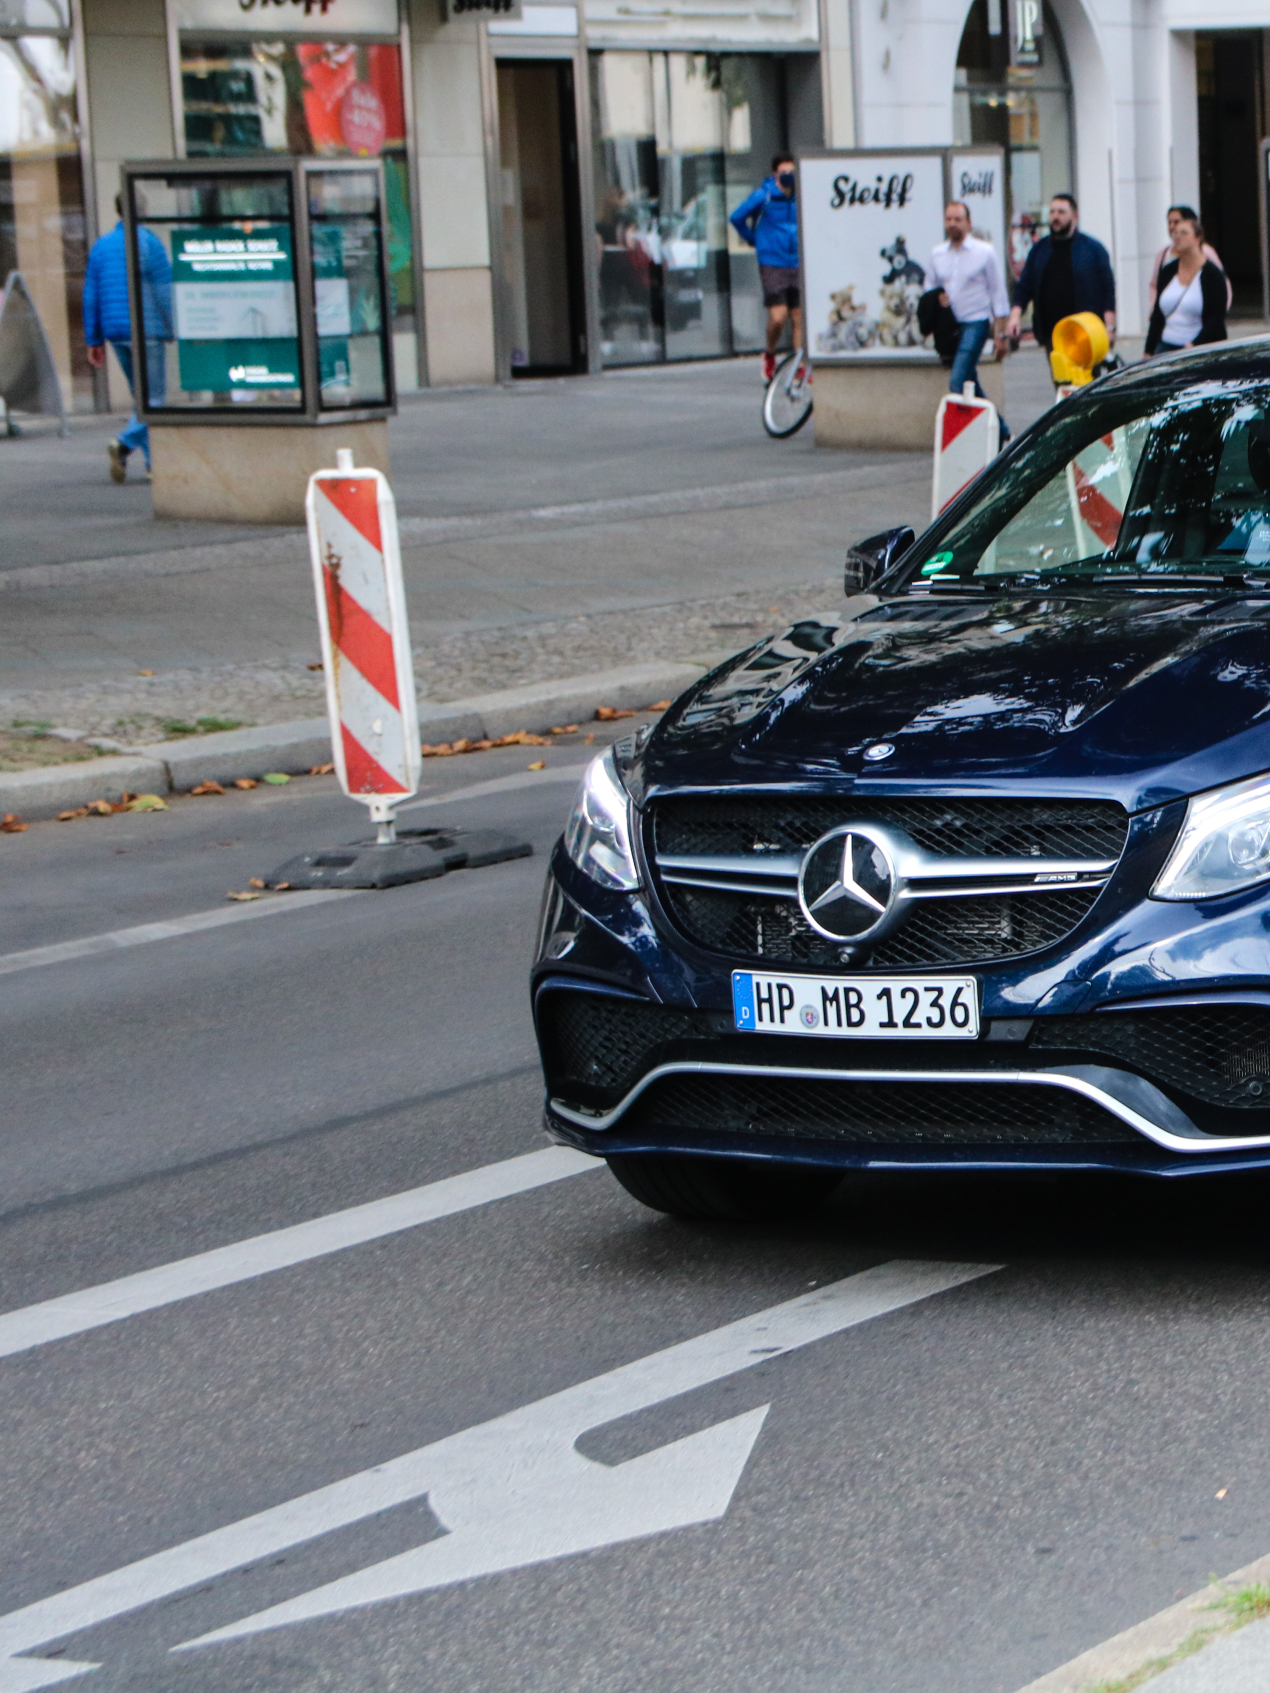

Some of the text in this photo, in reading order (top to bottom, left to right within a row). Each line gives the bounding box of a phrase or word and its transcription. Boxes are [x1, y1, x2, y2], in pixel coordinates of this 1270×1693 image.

[830, 173, 914, 210] Steiff
[960, 171, 995, 198] Steiff
[741, 981, 970, 1029] D HP MB 1236
